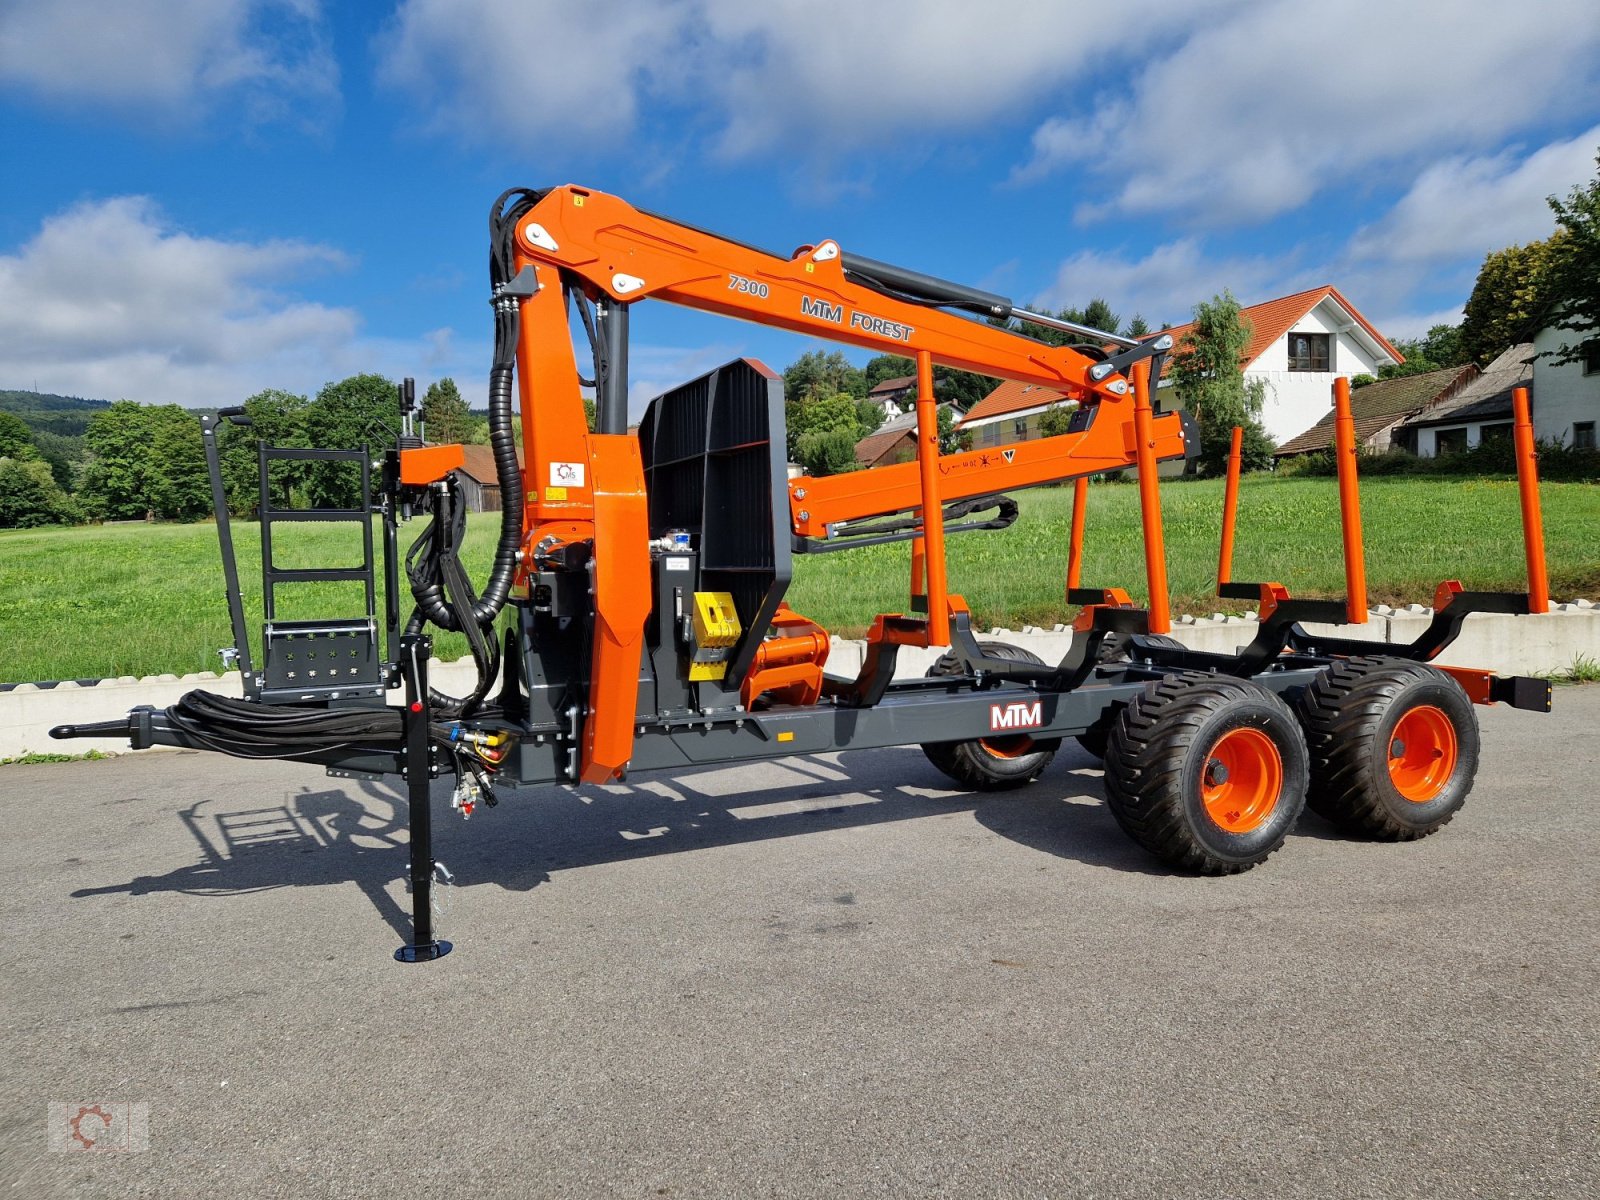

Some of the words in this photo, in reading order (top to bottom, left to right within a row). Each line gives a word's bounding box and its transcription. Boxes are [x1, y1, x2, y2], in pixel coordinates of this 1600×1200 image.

[728, 274, 769, 299] 7300
[801, 296, 843, 323] MTM
[850, 311, 914, 341] FOREST
[991, 701, 1042, 730] MTM
